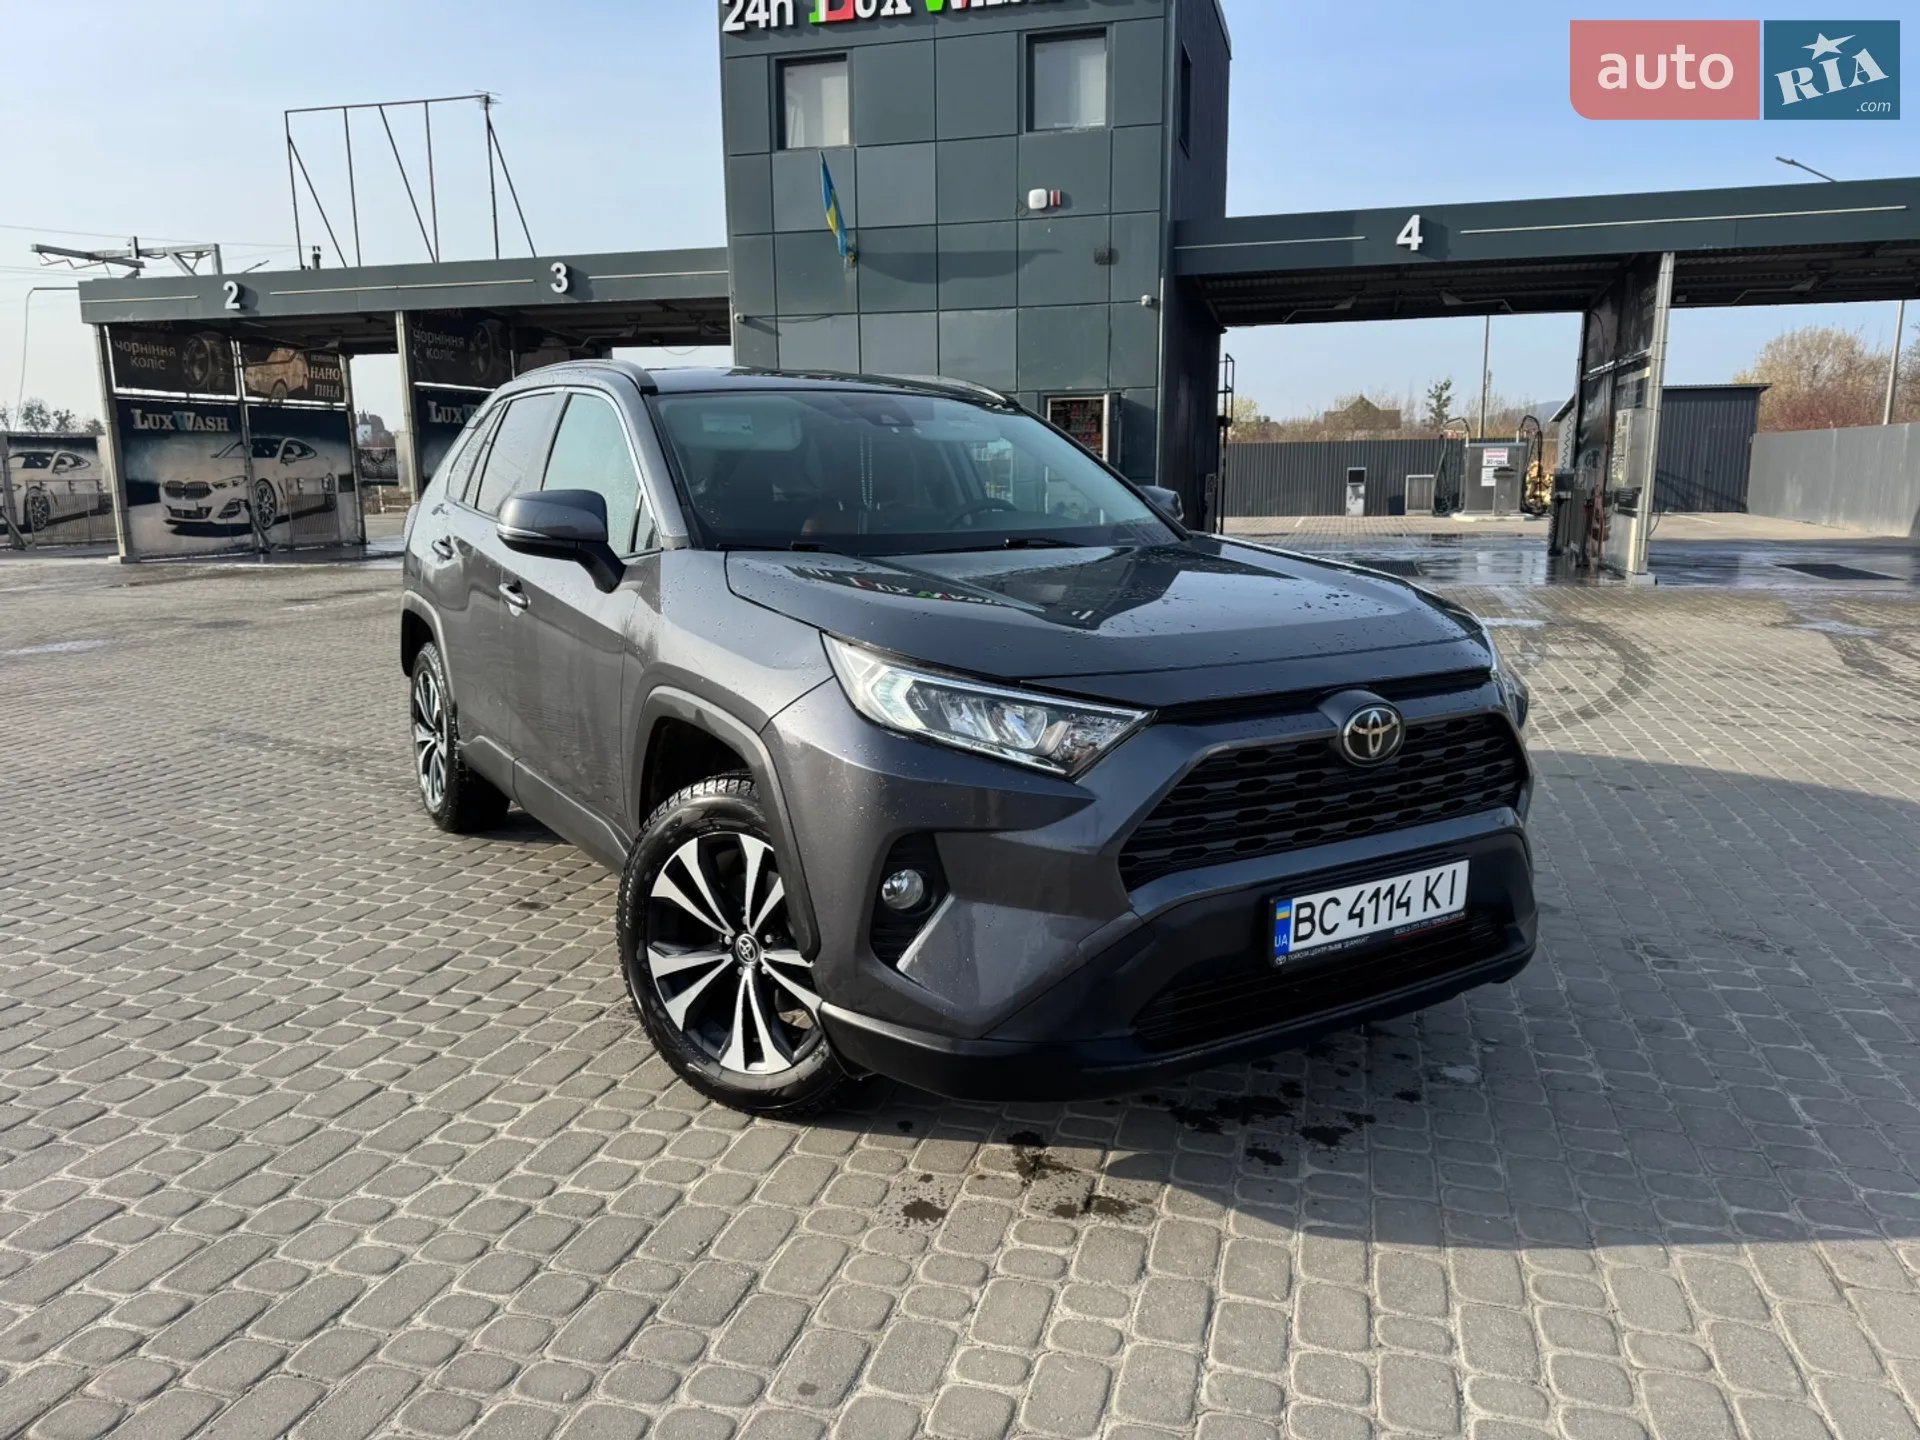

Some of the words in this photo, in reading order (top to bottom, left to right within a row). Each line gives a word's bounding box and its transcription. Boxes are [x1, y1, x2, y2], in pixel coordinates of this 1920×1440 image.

[1396, 214, 1423, 251] 4
[550, 261, 568, 294] 3
[223, 280, 240, 310] 2
[310, 366, 341, 381] НАНО
[314, 384, 340, 398] ПІНА
[1294, 897, 1341, 943] BC
[1347, 880, 1412, 928] 4114
[1423, 869, 1457, 912] KI
[1274, 934, 1288, 948] UA
